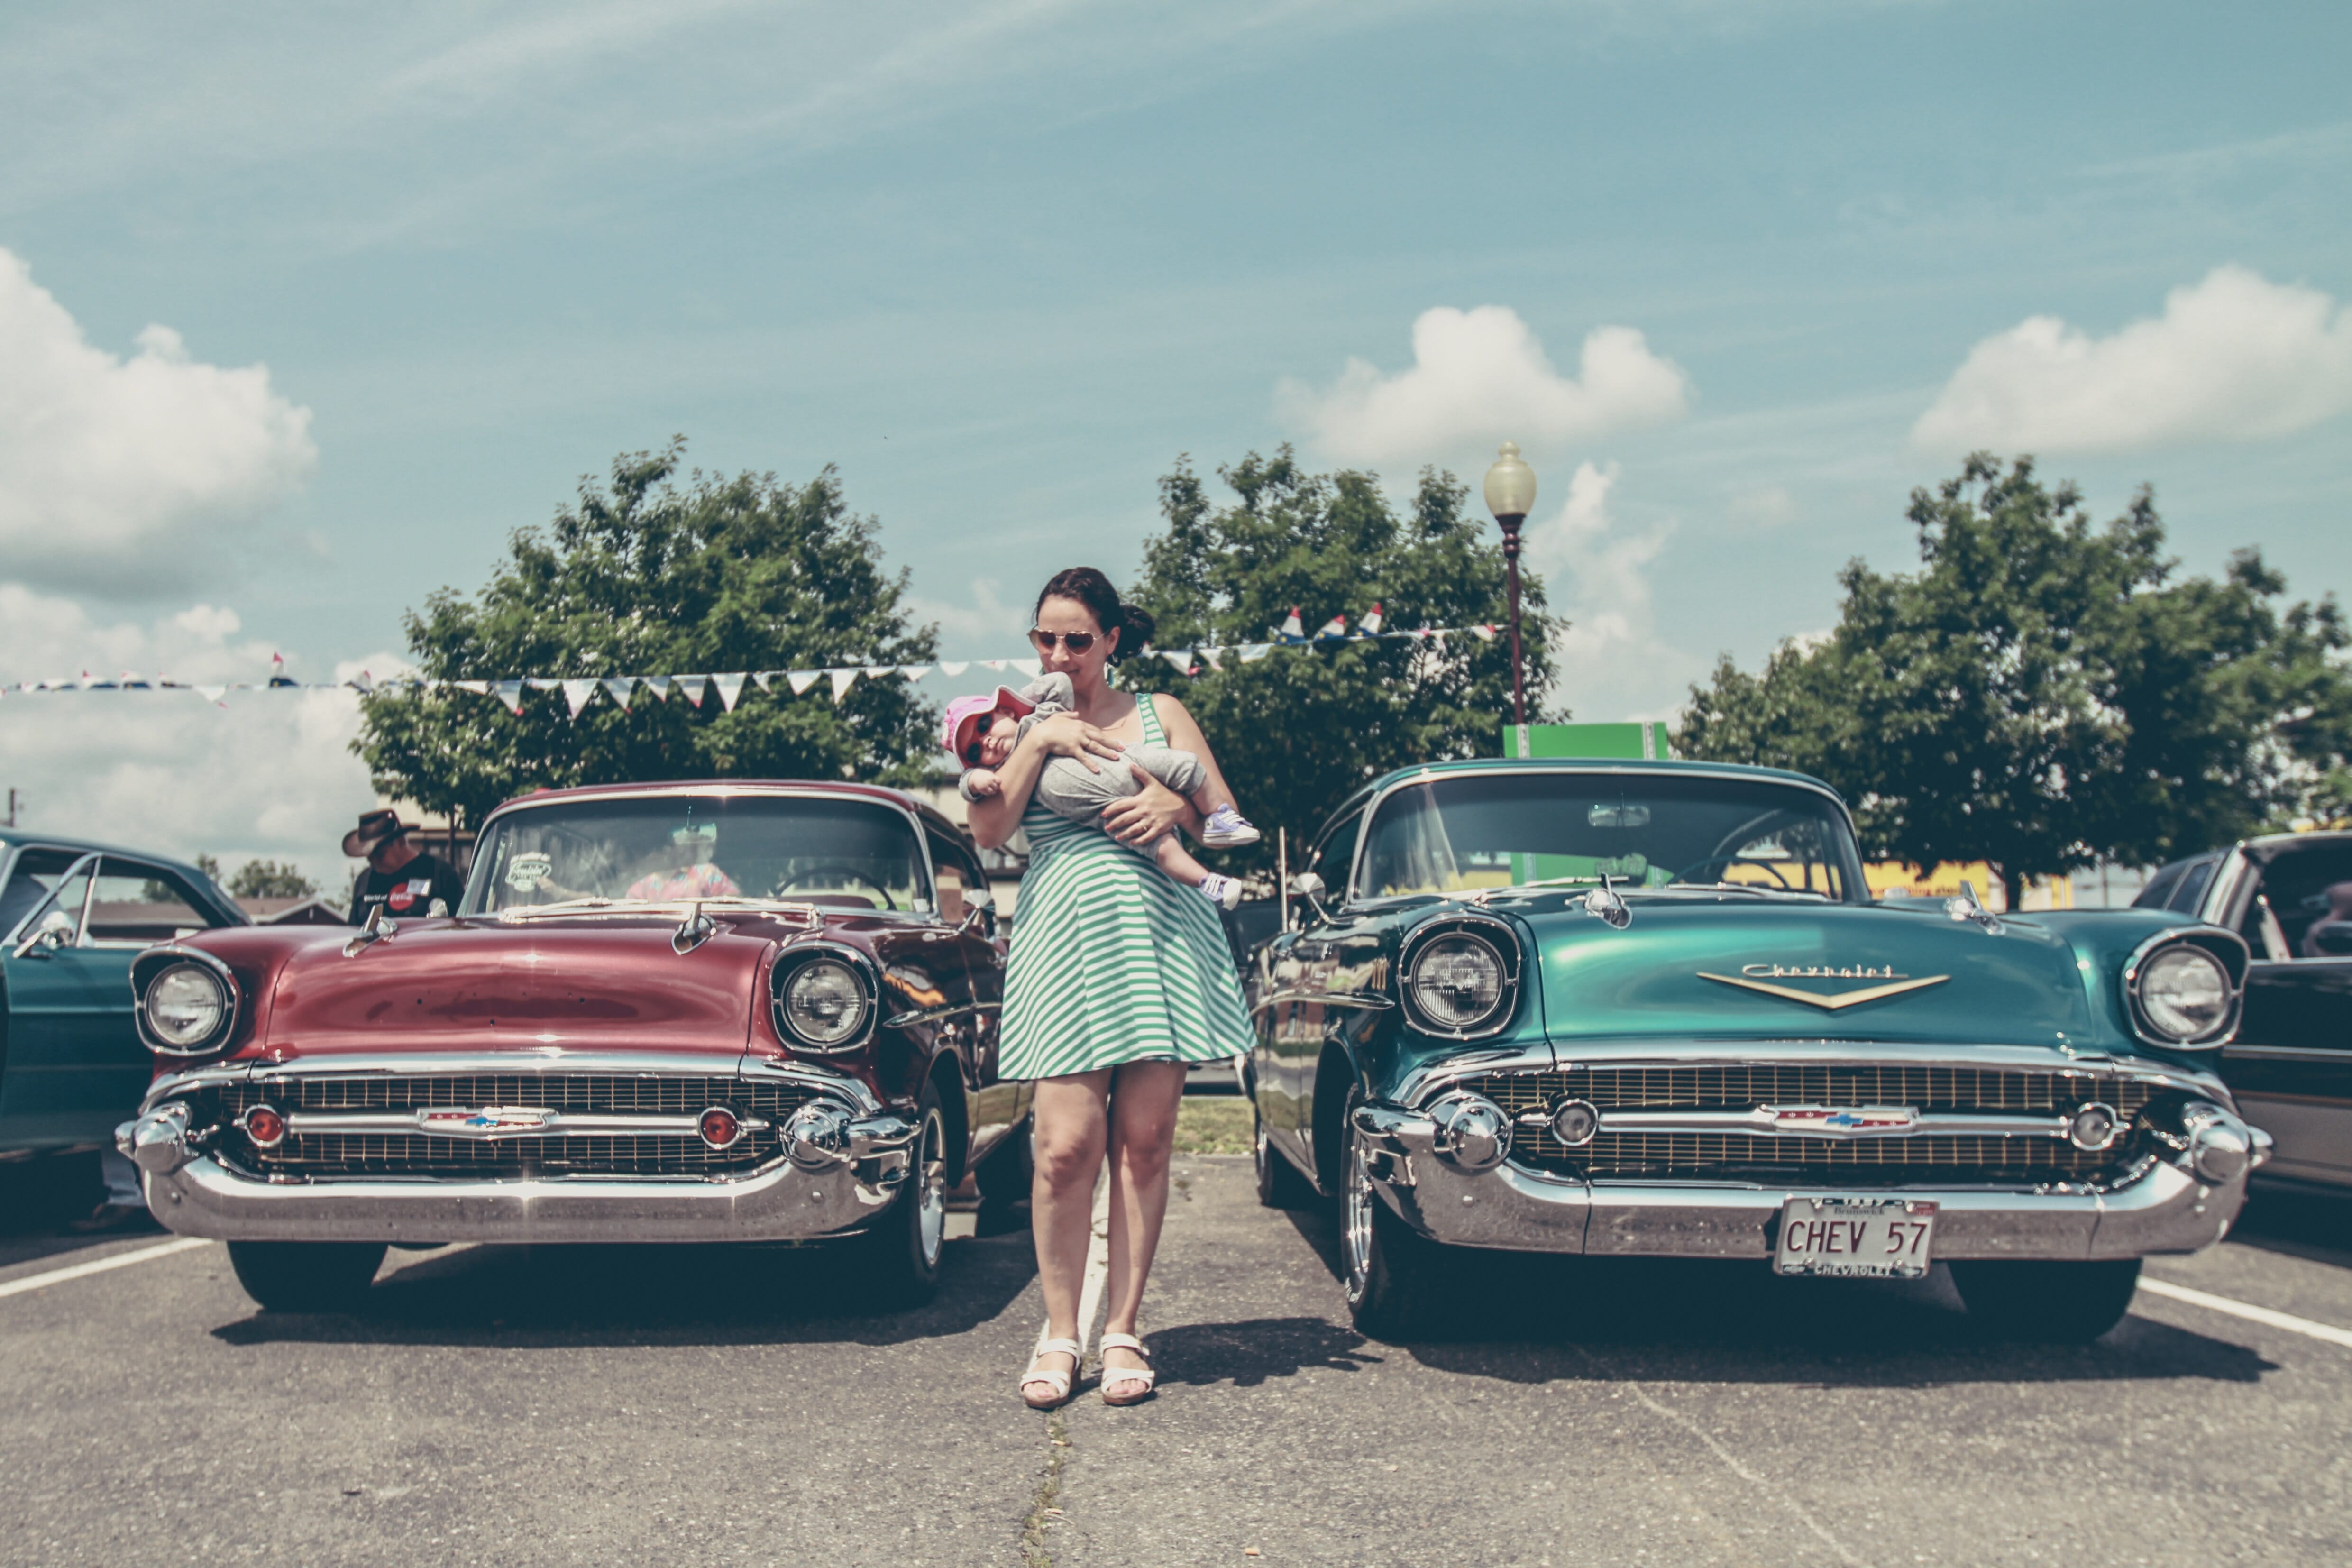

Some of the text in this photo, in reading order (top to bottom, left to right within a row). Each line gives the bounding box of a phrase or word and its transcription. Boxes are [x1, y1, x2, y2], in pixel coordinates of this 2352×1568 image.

[1742, 963, 1909, 978] Chevrolet
[1834, 1207, 1885, 1215] Brunswick
[1787, 1221, 1927, 1254] CHEV 57
[1814, 1265, 1891, 1276] CHEVROLET
